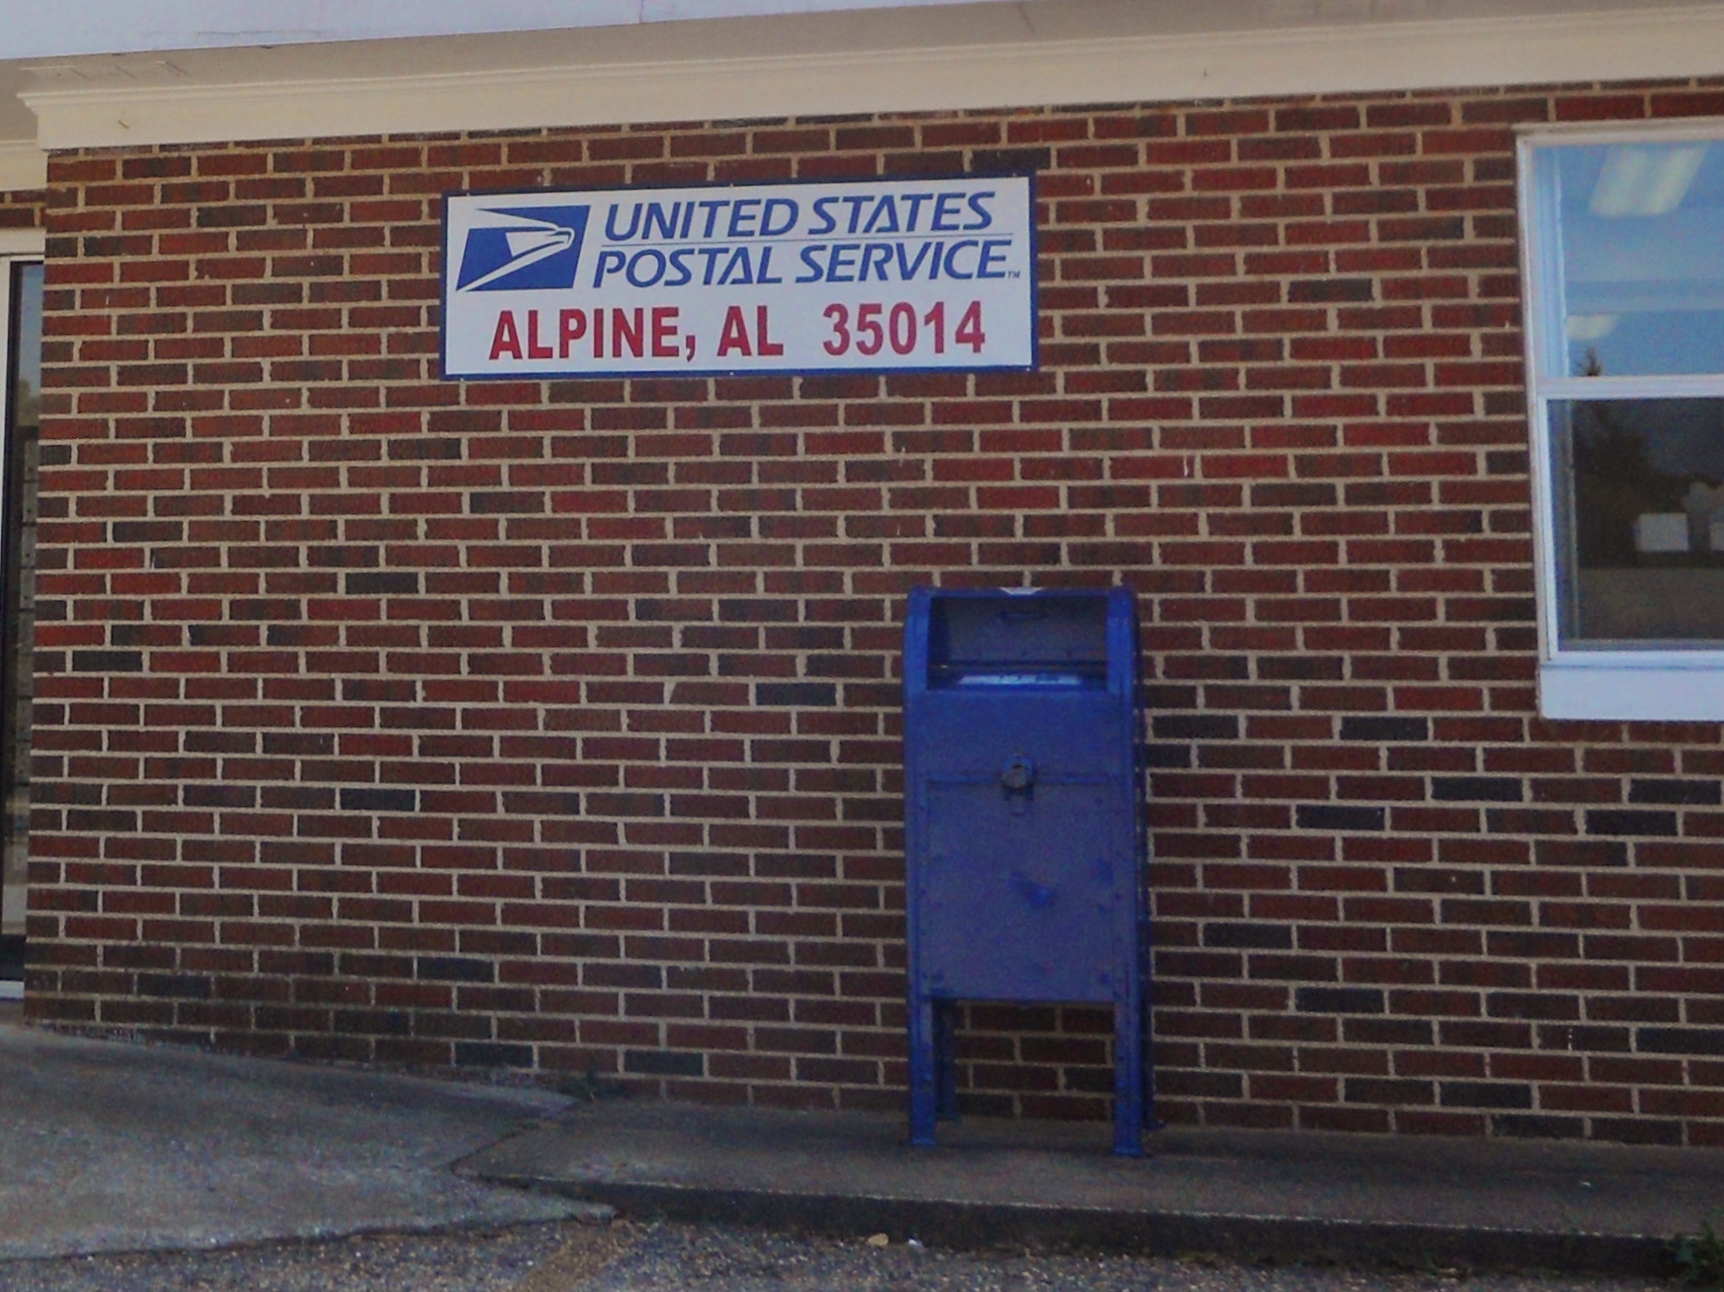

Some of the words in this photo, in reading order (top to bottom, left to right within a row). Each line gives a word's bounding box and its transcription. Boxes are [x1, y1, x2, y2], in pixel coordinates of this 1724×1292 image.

[604, 197, 800, 242] UNITED
[808, 191, 996, 235] STATES
[592, 245, 783, 289] POSTAL
[794, 240, 1011, 284] SERVICE
[489, 307, 697, 363] ALPINE,
[716, 305, 784, 357] AL
[822, 301, 986, 356] 35014
